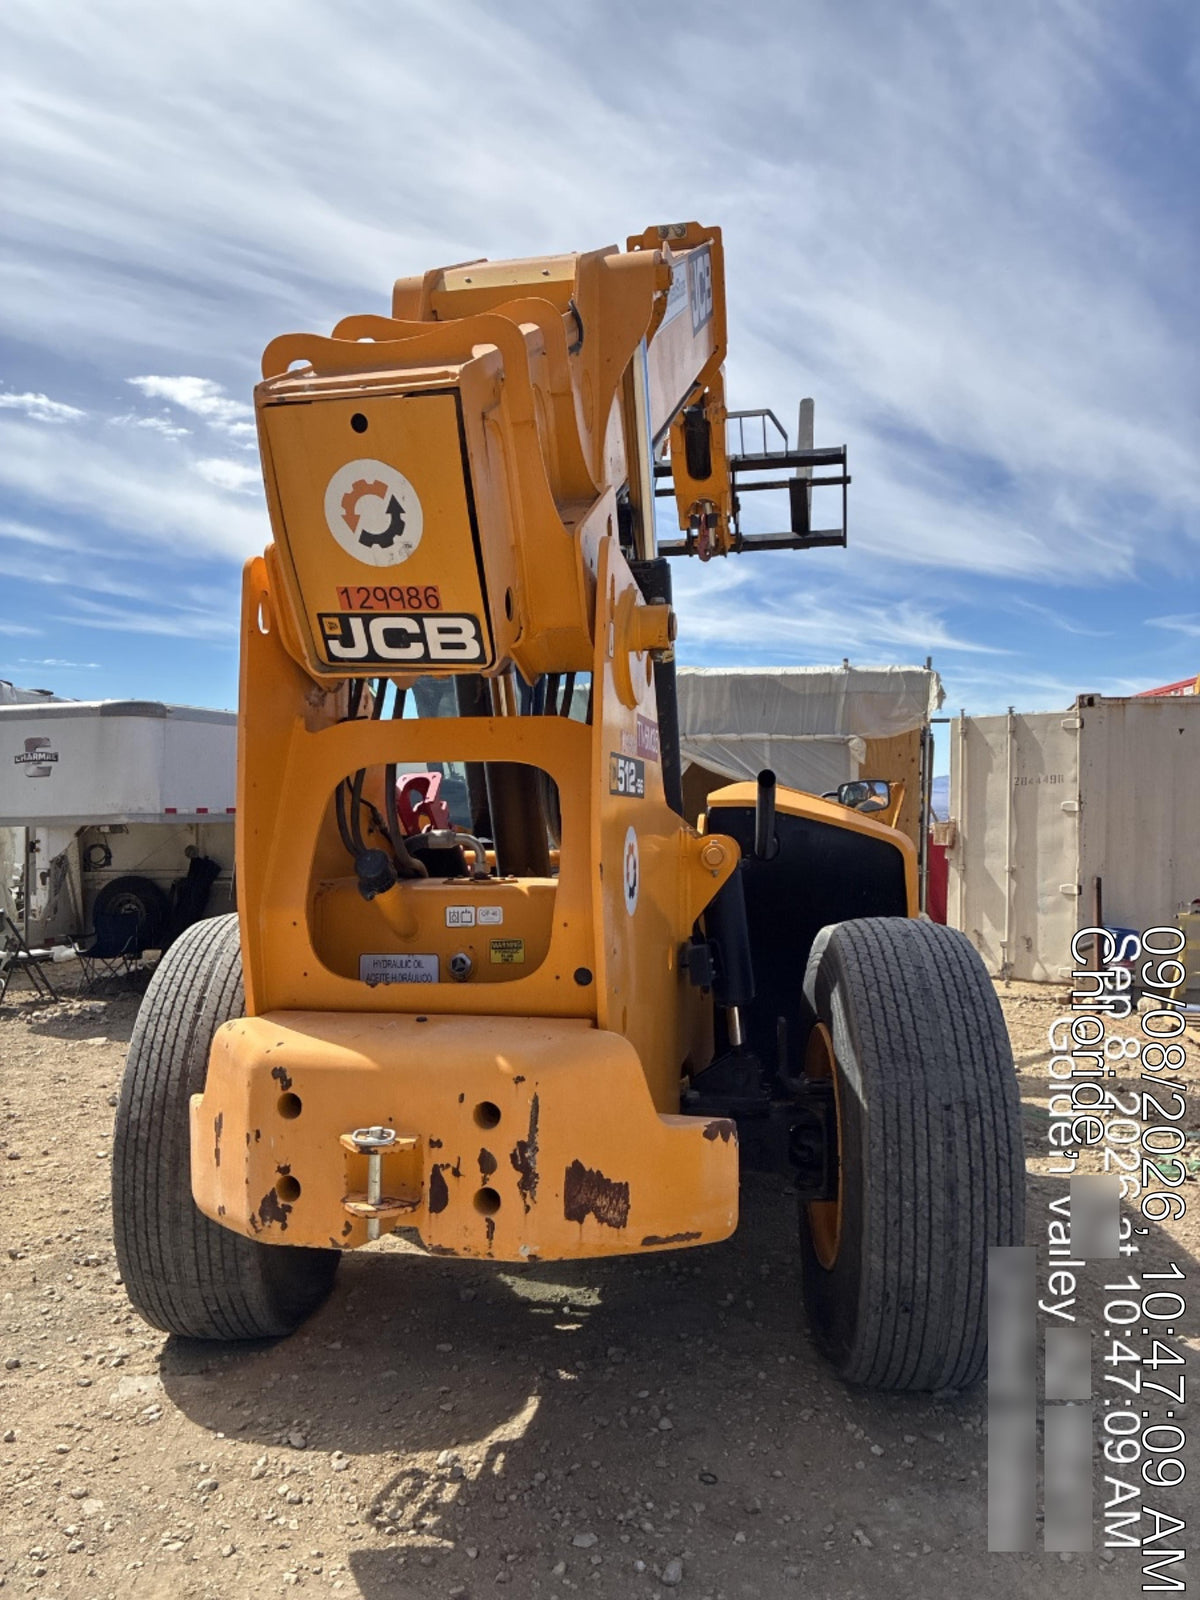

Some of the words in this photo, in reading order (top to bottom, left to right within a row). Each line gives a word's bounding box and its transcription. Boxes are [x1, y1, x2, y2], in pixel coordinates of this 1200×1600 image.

[340, 586, 440, 609] 129986
[327, 617, 481, 660] JCB
[618, 758, 636, 793] 512
[373, 959, 411, 969] HYDRAULIC
[413, 959, 424, 969] OIL
